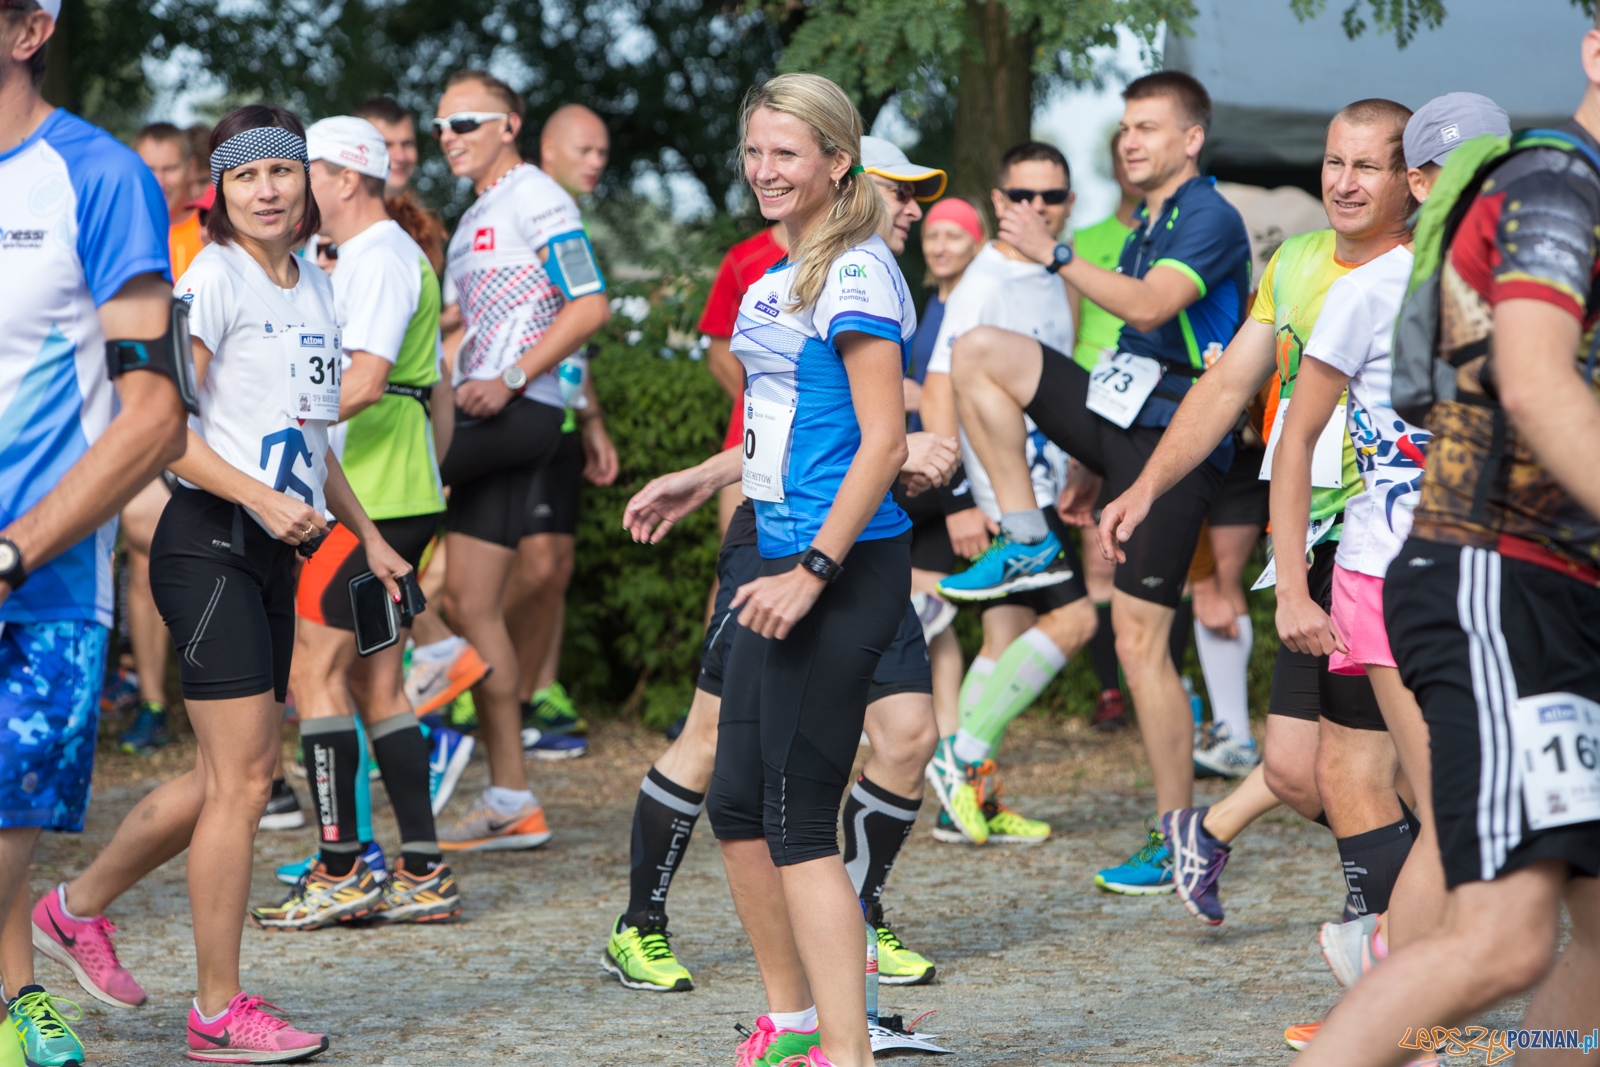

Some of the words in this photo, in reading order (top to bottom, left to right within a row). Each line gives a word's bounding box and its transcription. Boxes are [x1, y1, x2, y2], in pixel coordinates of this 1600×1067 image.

[839, 295, 869, 303] Pomorski
[743, 428, 756, 460] 0
[1542, 734, 1600, 772] 16
